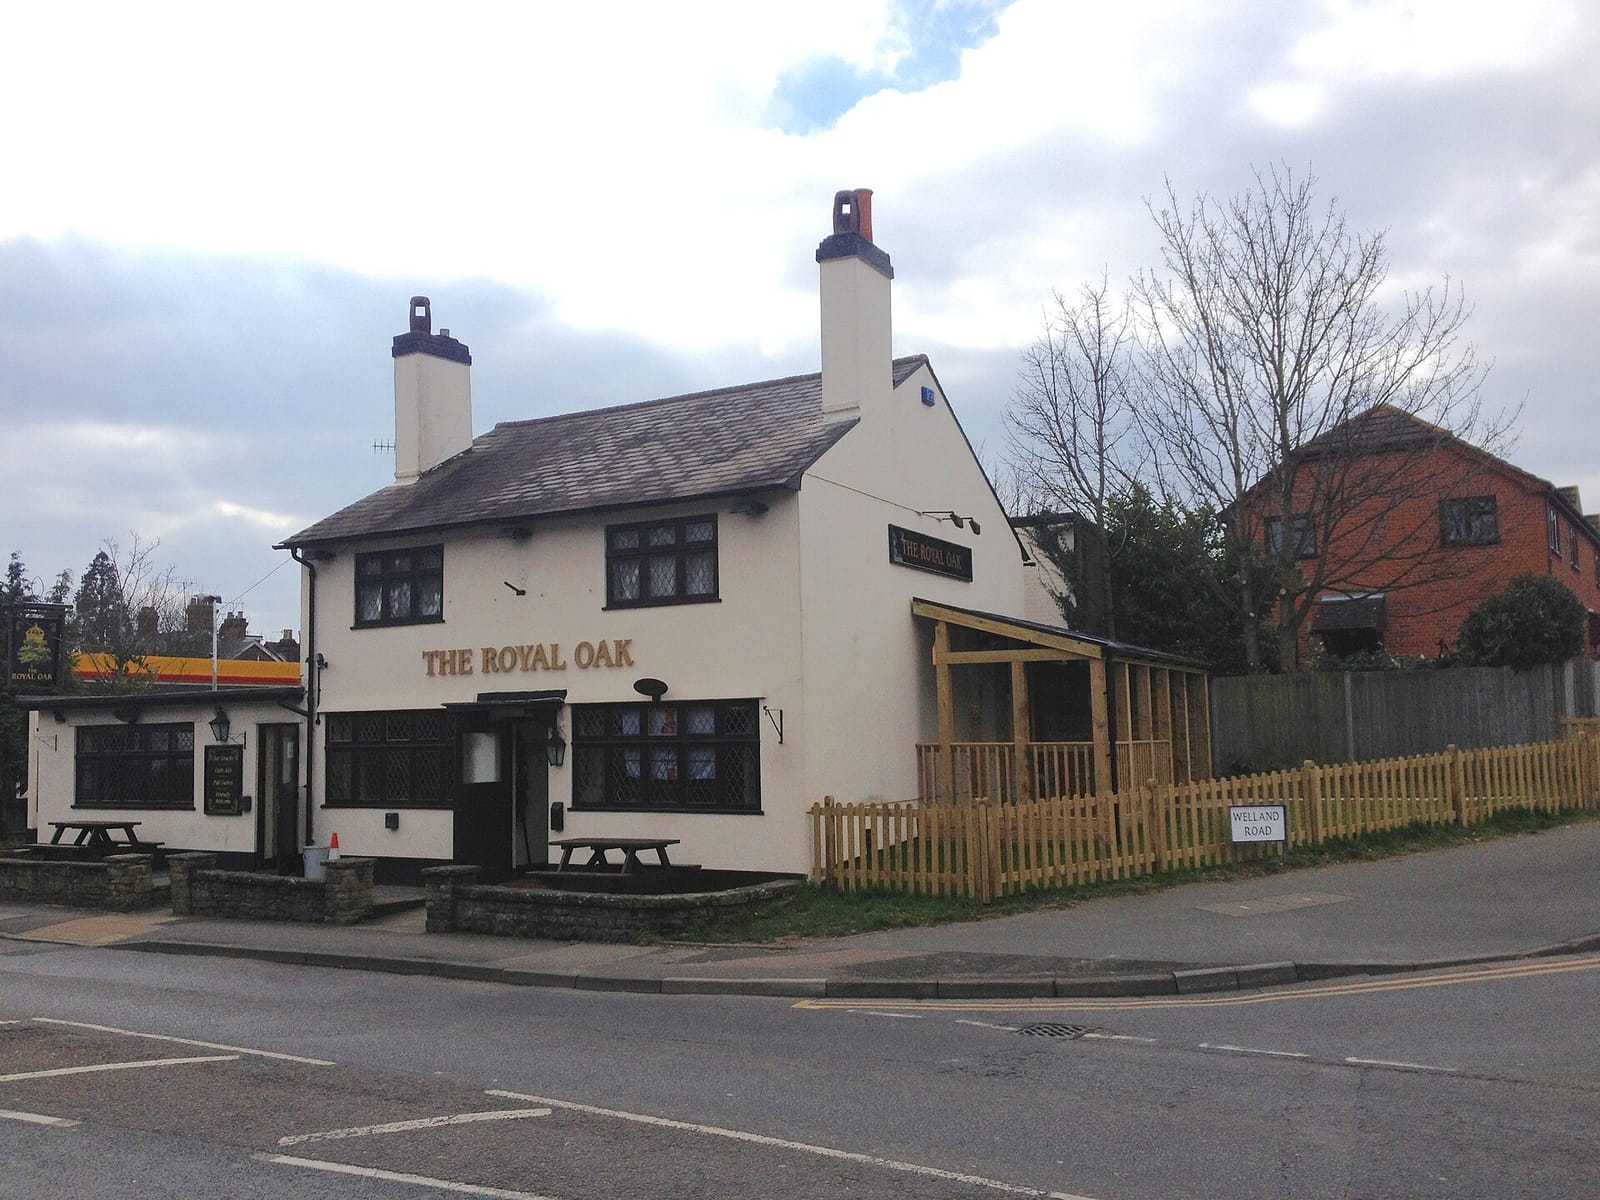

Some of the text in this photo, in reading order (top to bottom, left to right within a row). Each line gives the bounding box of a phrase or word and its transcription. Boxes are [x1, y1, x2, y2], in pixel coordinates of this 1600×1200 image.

[901, 539, 963, 570] THE ROYAL OAK
[422, 638, 635, 677] THE ROYAL OAK
[11, 672, 53, 680] ROYAL OAK
[1232, 811, 1280, 822] WELLAND
[1244, 825, 1272, 836] ROAD
